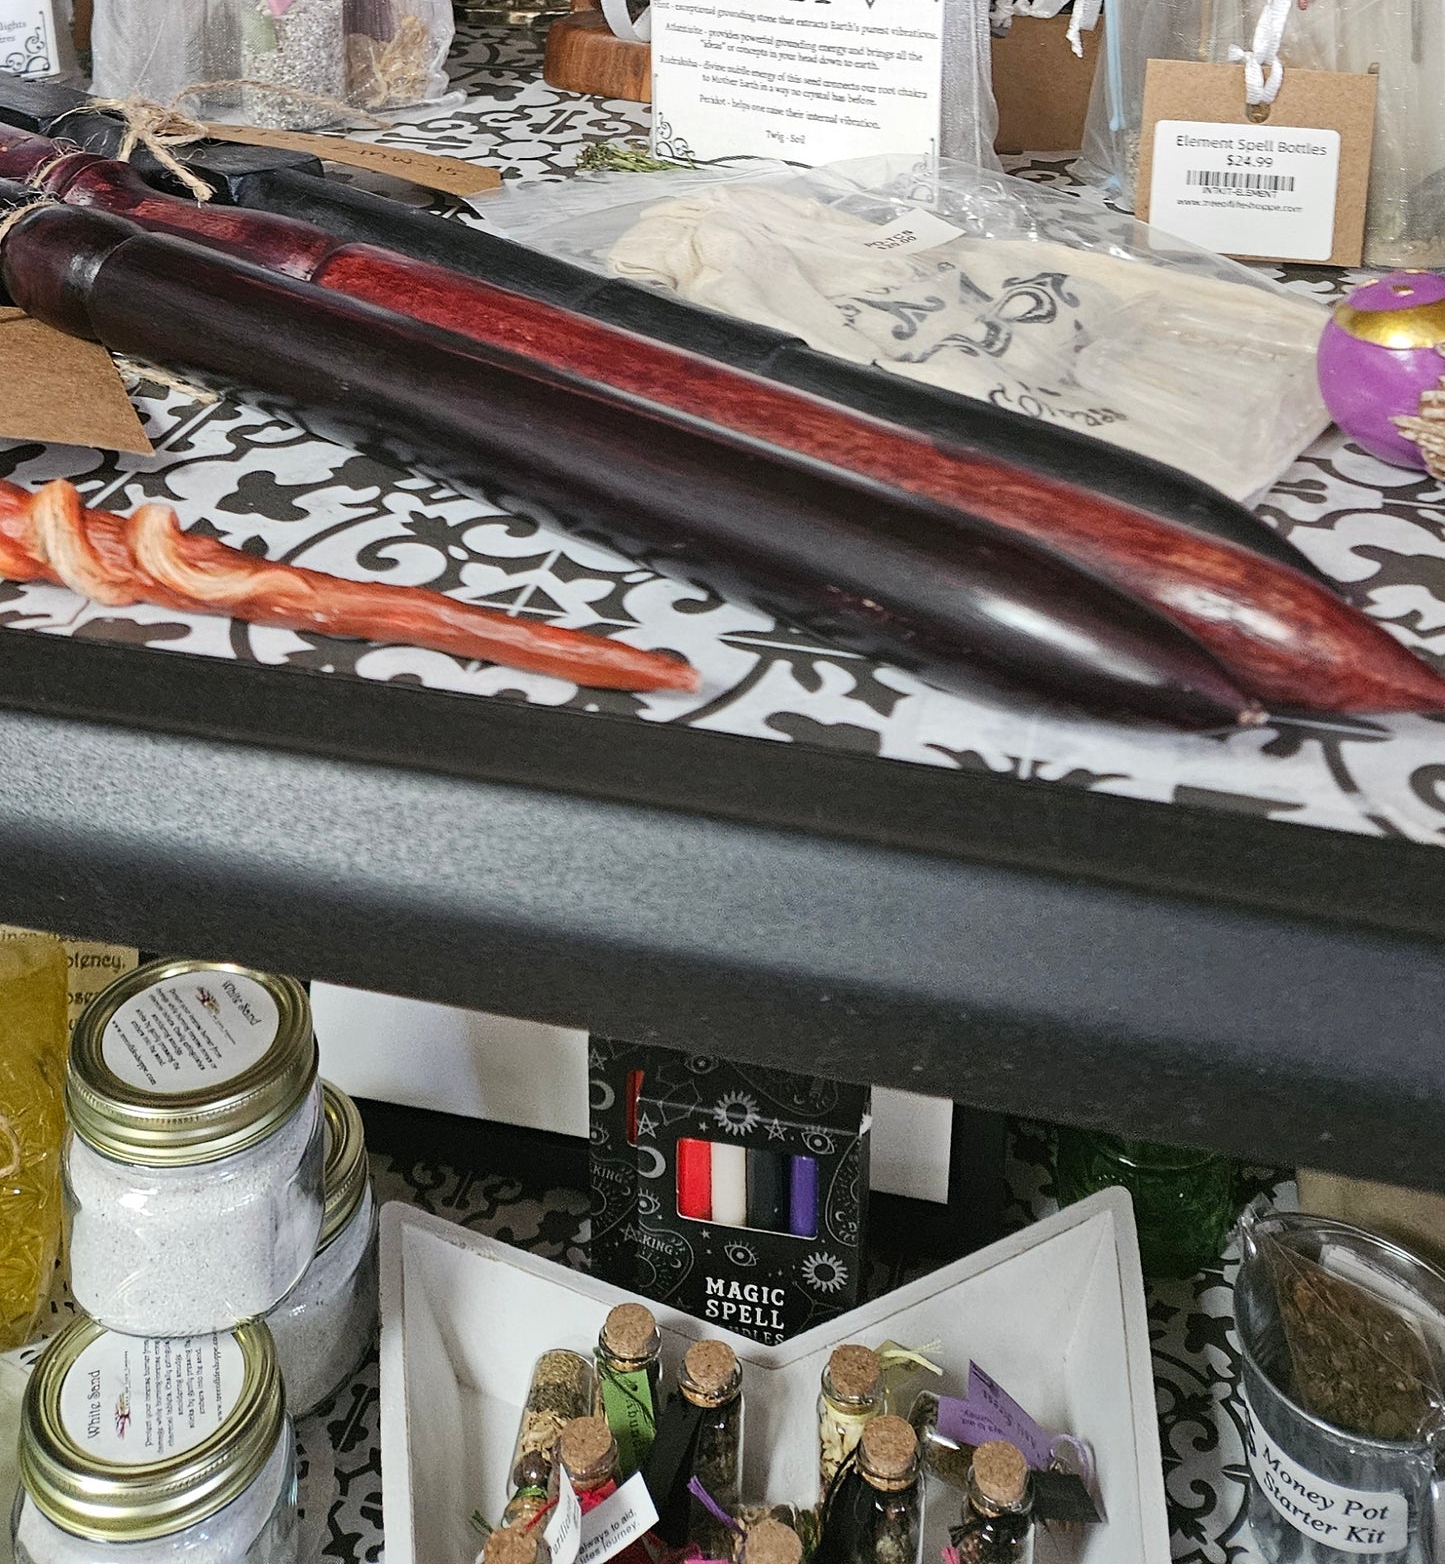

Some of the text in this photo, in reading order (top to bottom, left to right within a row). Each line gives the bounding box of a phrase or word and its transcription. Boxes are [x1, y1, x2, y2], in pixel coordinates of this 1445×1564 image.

[718, 9, 756, 22] grounding
[756, 14, 777, 23] stone
[778, 15, 795, 25] that
[796, 20, 828, 28] extracts
[831, 21, 859, 32] Earth's
[862, 26, 890, 36] purest
[708, 30, 740, 40] provides
[740, 35, 774, 45] powerful
[776, 39, 816, 53] grounding
[818, 45, 846, 56] energy
[848, 47, 864, 55] and
[866, 48, 895, 62] brings
[896, 50, 906, 60] all
[908, 51, 923, 61] the
[736, 46, 768, 58] concepts
[770, 50, 776, 58] in
[778, 52, 796, 61] your
[798, 52, 817, 63] head
[819, 56, 842, 66] down
[854, 61, 880, 70] earth.
[702, 74, 710, 82] to
[712, 76, 738, 86] Mother
[740, 79, 758, 89] Earth
[760, 82, 768, 91] in
[776, 86, 789, 97] way
[803, 91, 830, 100] crystal
[832, 92, 845, 102] has
[848, 94, 877, 106] before.
[703, 61, 726, 72] divine
[752, 70, 776, 82] energy
[778, 73, 784, 81] of
[786, 74, 802, 84] this
[804, 77, 821, 86] seed
[823, 81, 860, 90] connects
[878, 87, 896, 95] root
[898, 87, 928, 98] chakra
[700, 94, 726, 106] Peridot
[732, 98, 750, 111] helps
[752, 104, 766, 112] one
[766, 106, 784, 116] raise
[786, 108, 804, 118] their
[806, 111, 837, 124] internal
[840, 116, 880, 129] vibration.
[765, 130, 784, 144] Twig
[790, 135, 806, 144] Soil
[1176, 135, 1327, 156] Element Spell Bottles
[1226, 154, 1273, 168] $24.99
[706, 1276, 785, 1306] MAGIC
[705, 1299, 785, 1330] SPELL
[87, 1369, 101, 1439] White Sand
[1263, 1444, 1388, 1520] Money Pot
[1264, 1472, 1385, 1544] Starter Kit
[580, 1508, 636, 1554] always to aid.
[602, 1521, 640, 1552] journey.
